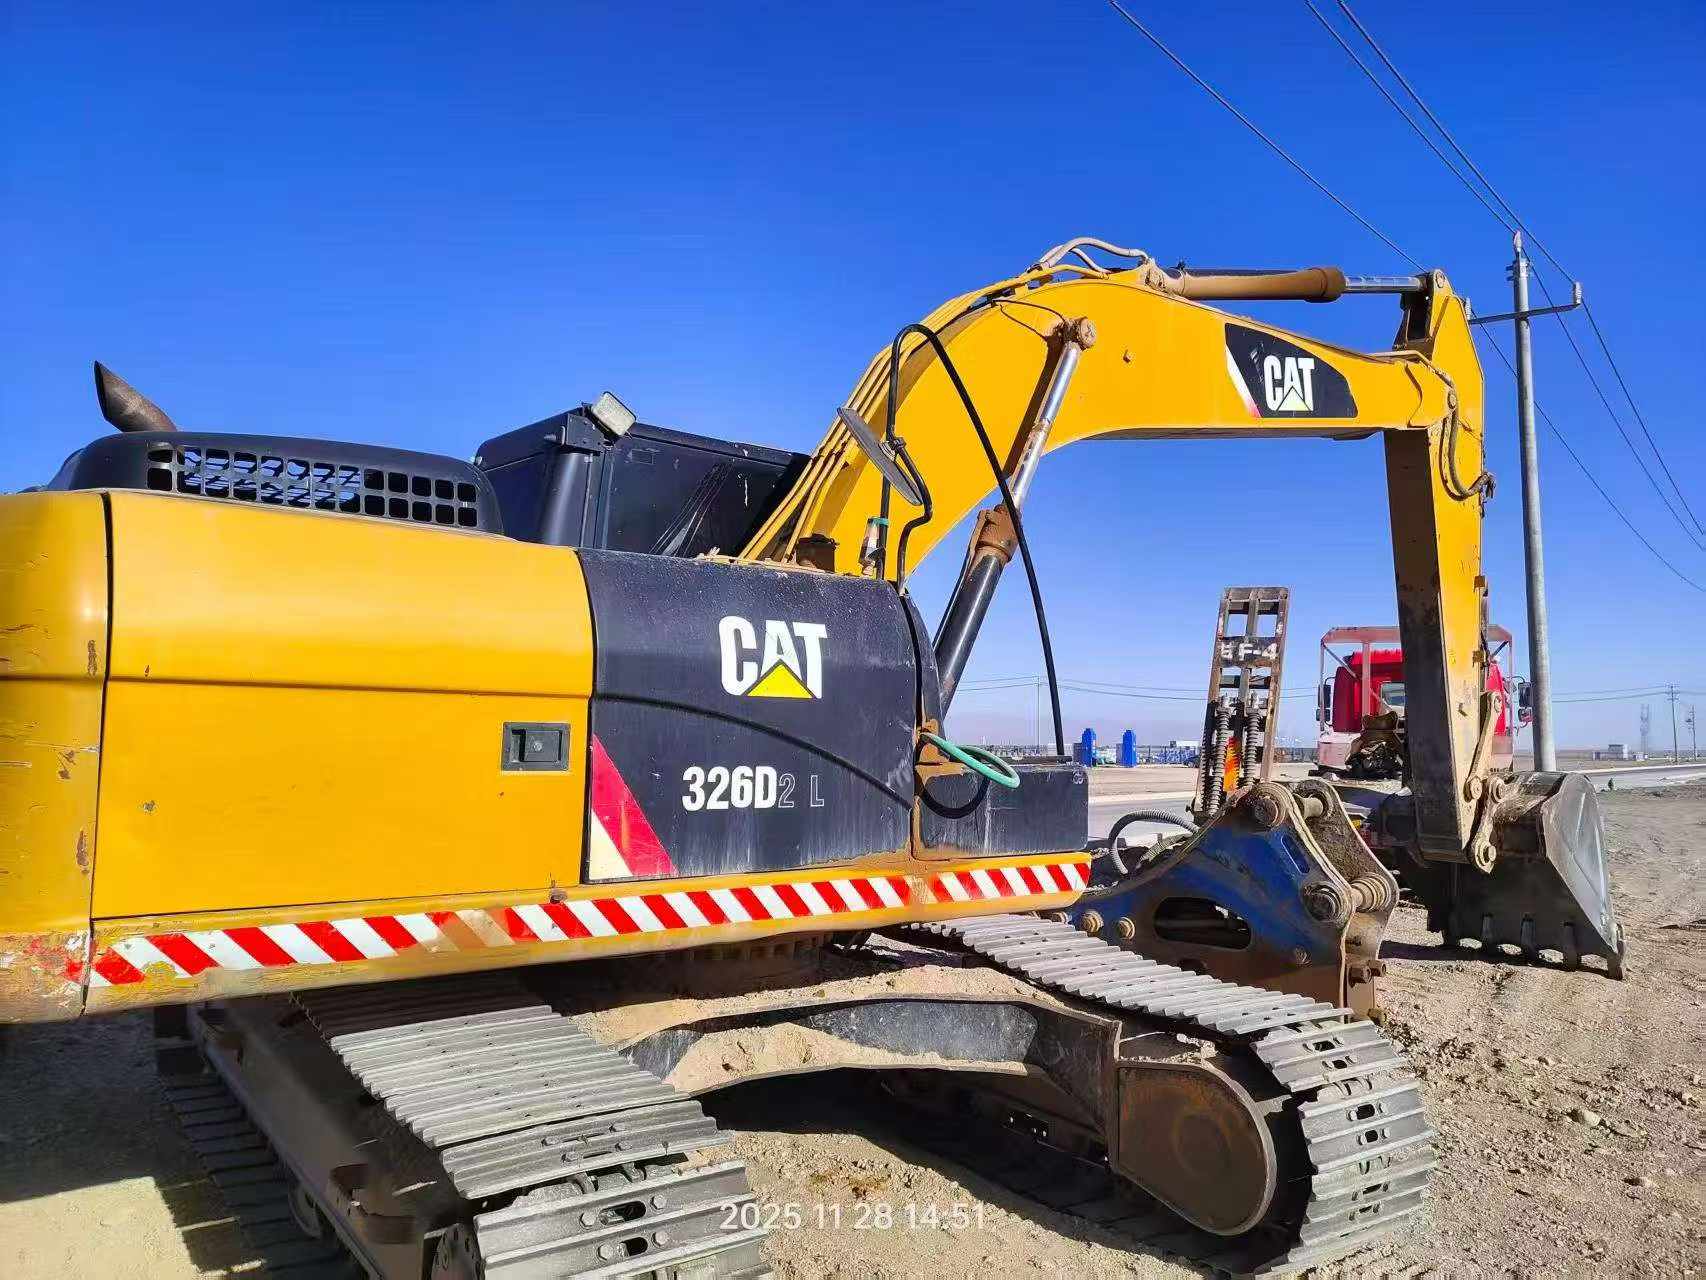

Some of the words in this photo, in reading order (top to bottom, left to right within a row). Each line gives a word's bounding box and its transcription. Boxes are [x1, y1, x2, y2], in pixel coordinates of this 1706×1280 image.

[1263, 354, 1315, 412] CAT
[718, 615, 828, 699] CAT
[681, 765, 796, 812] 326D2
[809, 774, 825, 807] L
